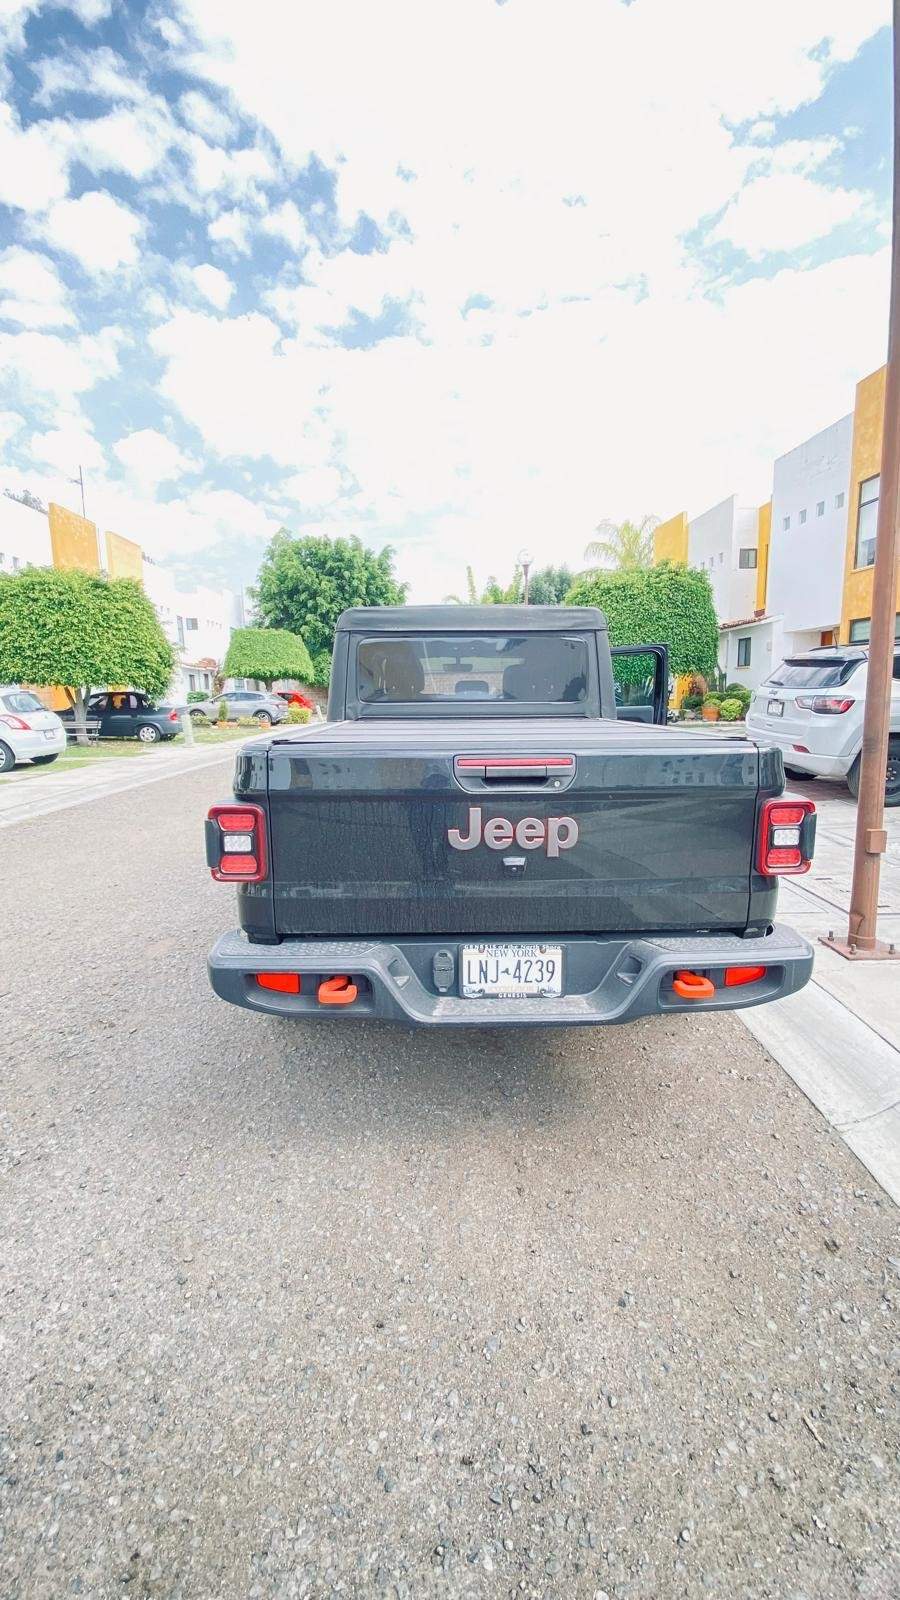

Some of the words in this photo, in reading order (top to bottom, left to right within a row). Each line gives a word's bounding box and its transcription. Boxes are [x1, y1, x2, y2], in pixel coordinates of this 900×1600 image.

[448, 807, 579, 858] Jeep
[486, 949, 508, 958] NEW
[511, 949, 538, 958] YORK
[467, 959, 499, 984] LNJ
[513, 959, 555, 983] 4239
